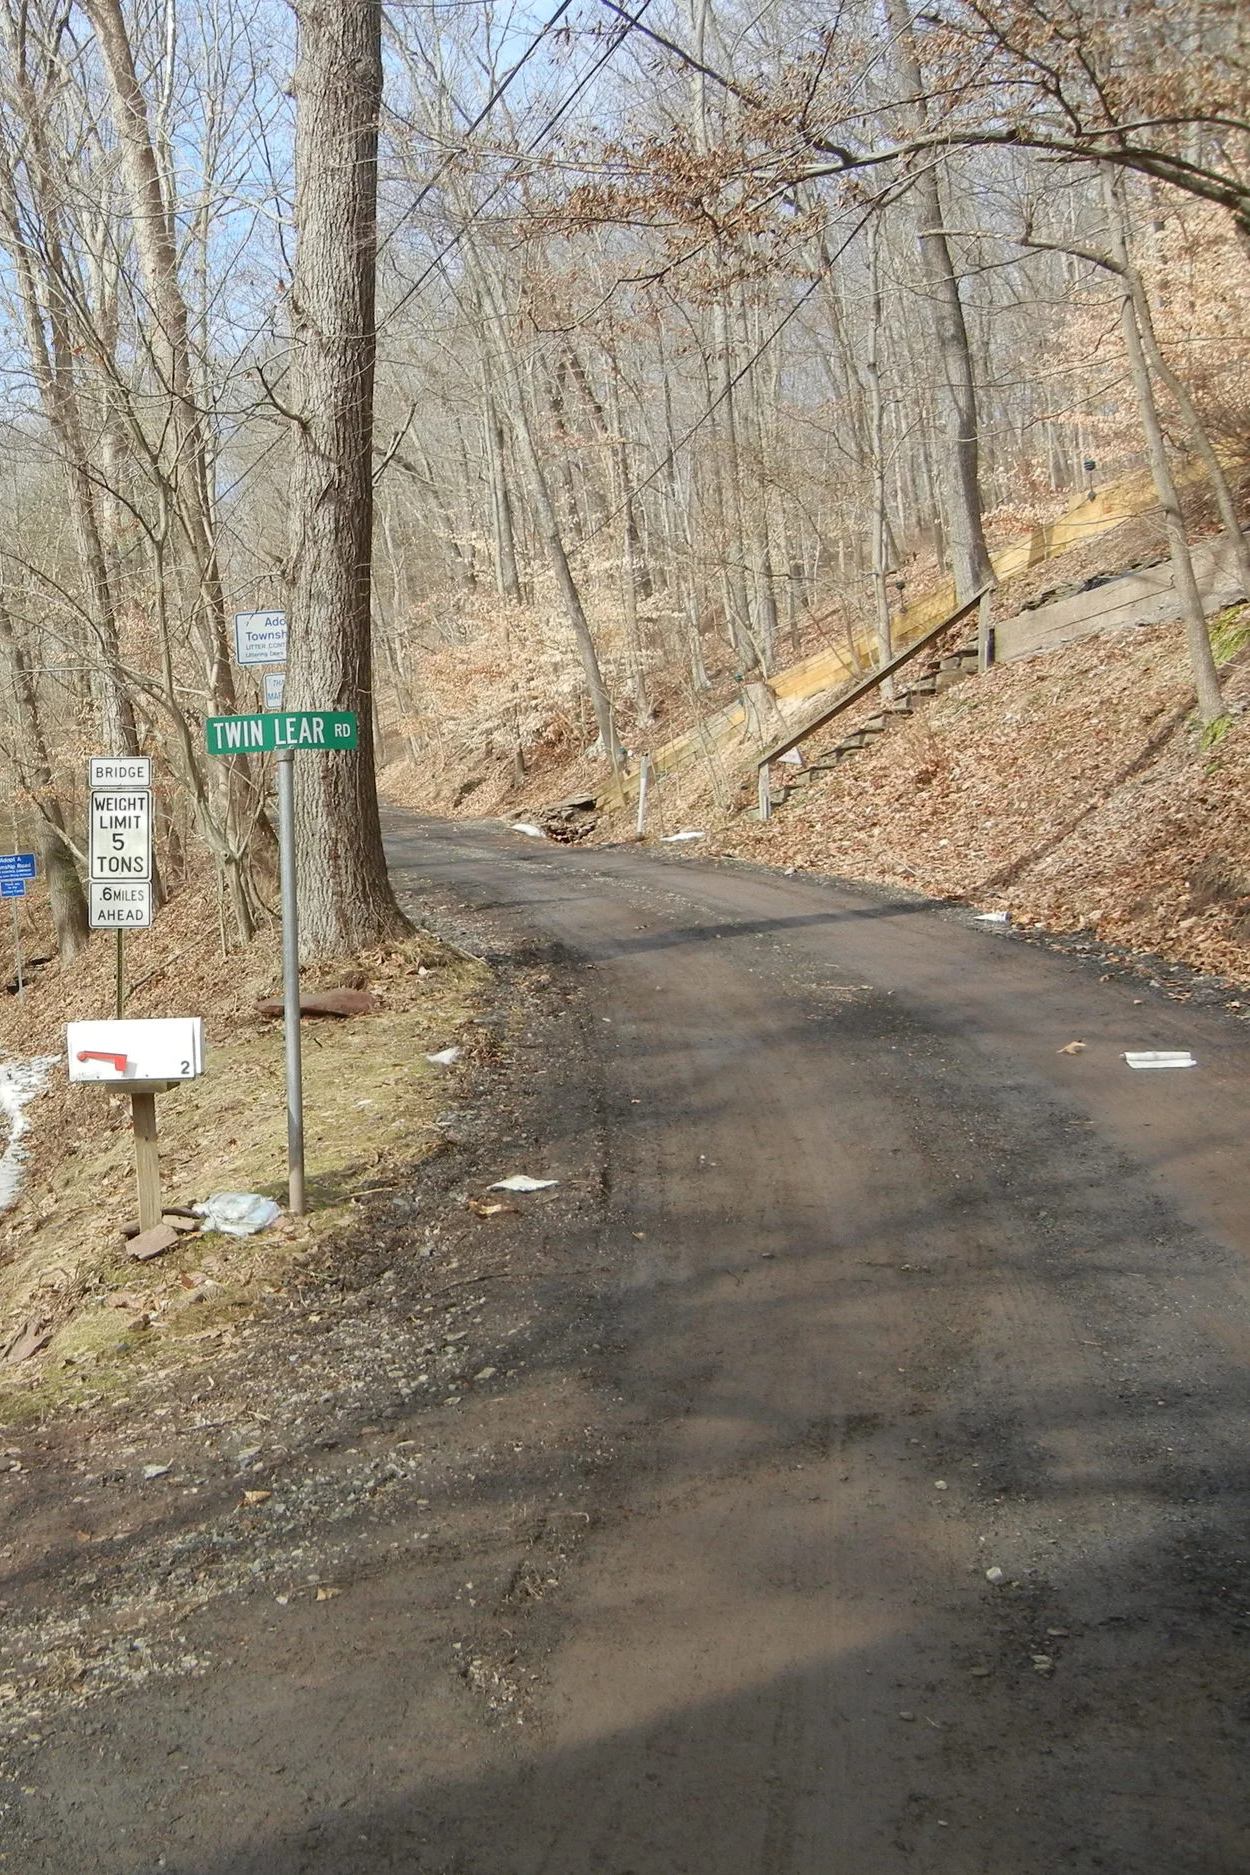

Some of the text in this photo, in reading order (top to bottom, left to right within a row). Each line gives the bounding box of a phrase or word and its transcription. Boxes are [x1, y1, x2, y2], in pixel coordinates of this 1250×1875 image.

[264, 616, 287, 627] Ado
[245, 630, 287, 641] Townsh
[268, 641, 286, 649] CONT
[213, 716, 351, 749] TWIN LEAR RD
[96, 766, 144, 778] BRIDGE
[94, 797, 146, 811] WEIGHT
[100, 815, 142, 829] LIMIT
[112, 833, 125, 851] 5
[97, 856, 144, 872] TONS
[97, 909, 144, 921] AHEAD
[180, 1060, 191, 1075] 2
